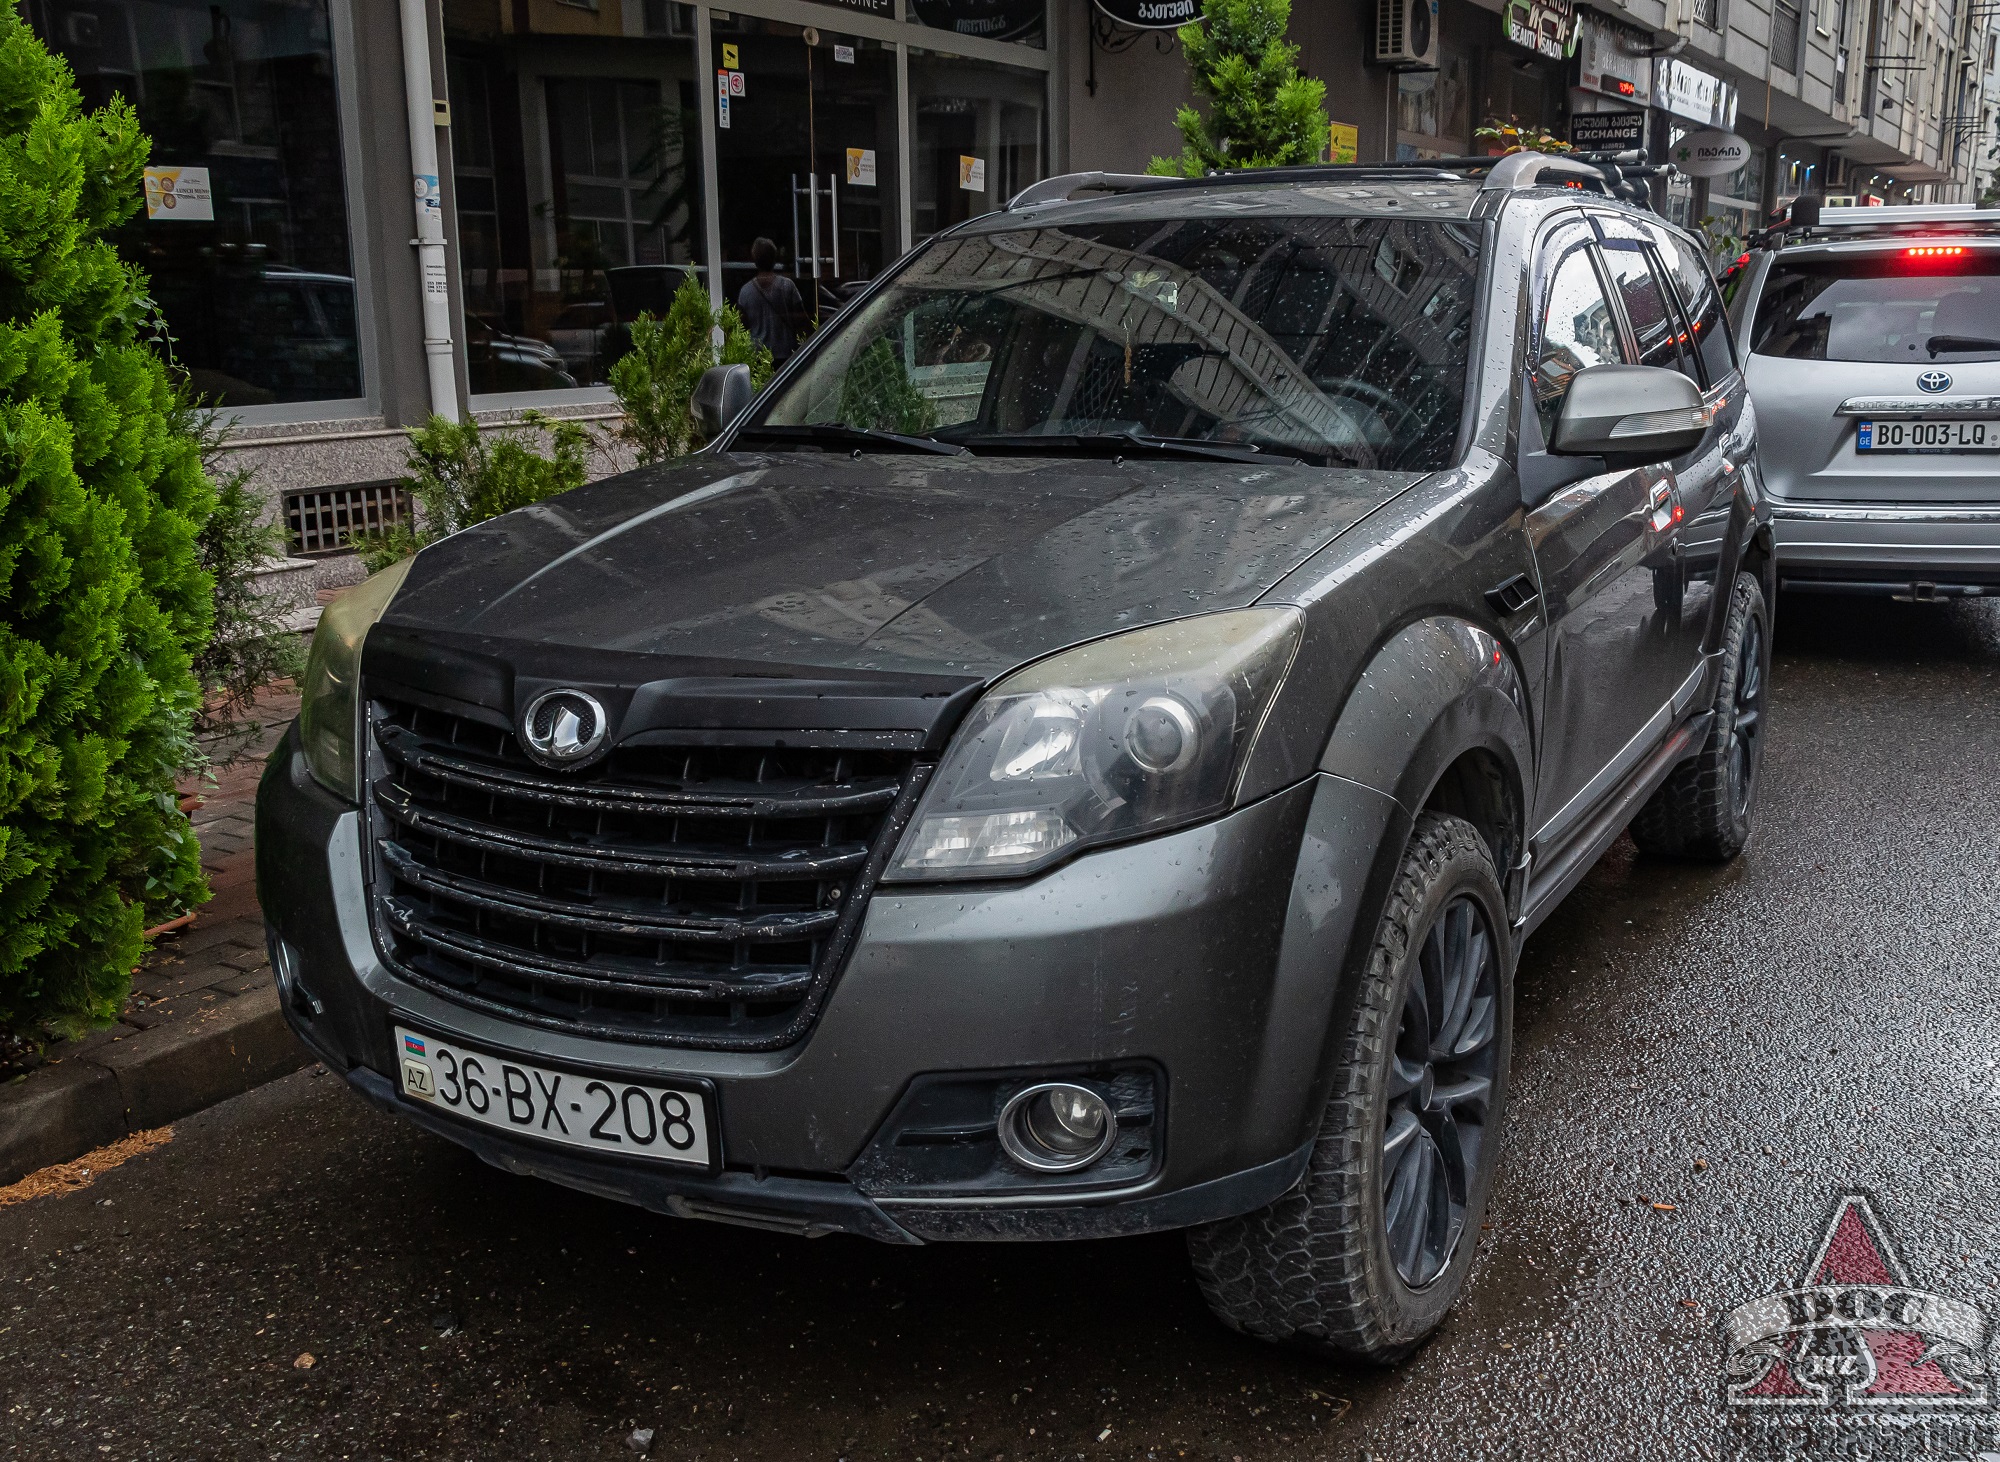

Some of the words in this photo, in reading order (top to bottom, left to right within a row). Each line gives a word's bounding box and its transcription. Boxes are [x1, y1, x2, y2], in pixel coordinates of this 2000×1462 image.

[1138, 0, 1195, 19] ბათუმი
[1511, 23, 1537, 50] BEAUTY
[1541, 37, 1563, 61] SALON
[1577, 128, 1638, 140] EXCHANGE
[1698, 147, 1741, 157] იბერია
[1859, 436, 1871, 446] GE
[1877, 424, 1986, 446] BO-003-LQ
[407, 1068, 428, 1092] AZ
[435, 1048, 697, 1150] 36-BX-208
